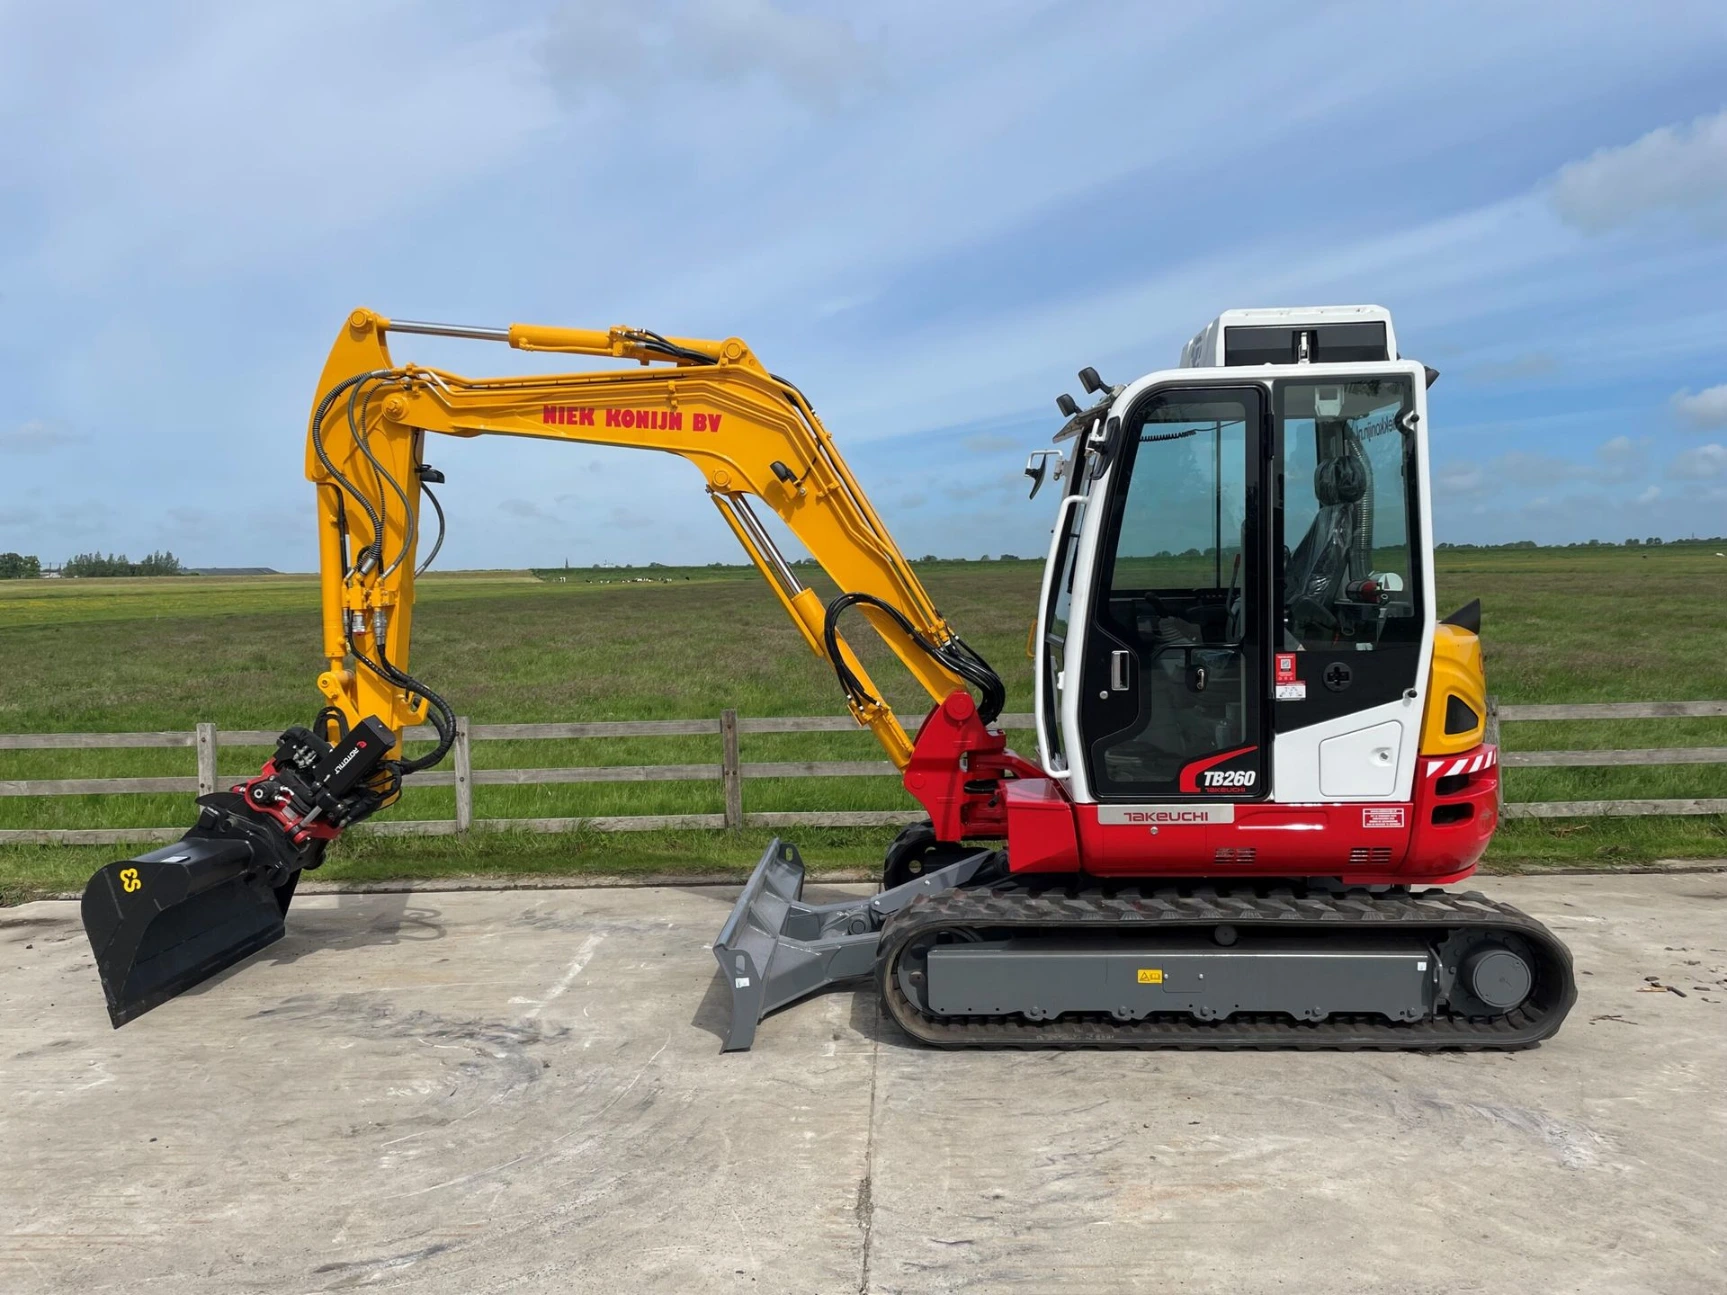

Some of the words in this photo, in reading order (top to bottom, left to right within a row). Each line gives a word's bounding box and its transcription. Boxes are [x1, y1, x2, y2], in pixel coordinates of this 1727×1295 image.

[543, 404, 595, 426] NIEK
[605, 408, 682, 431] KONIJN
[692, 413, 722, 432] BV
[334, 746, 360, 775] ROTOTILT
[1204, 770, 1256, 786] TB260
[1123, 811, 1208, 822] TAKEUCHI
